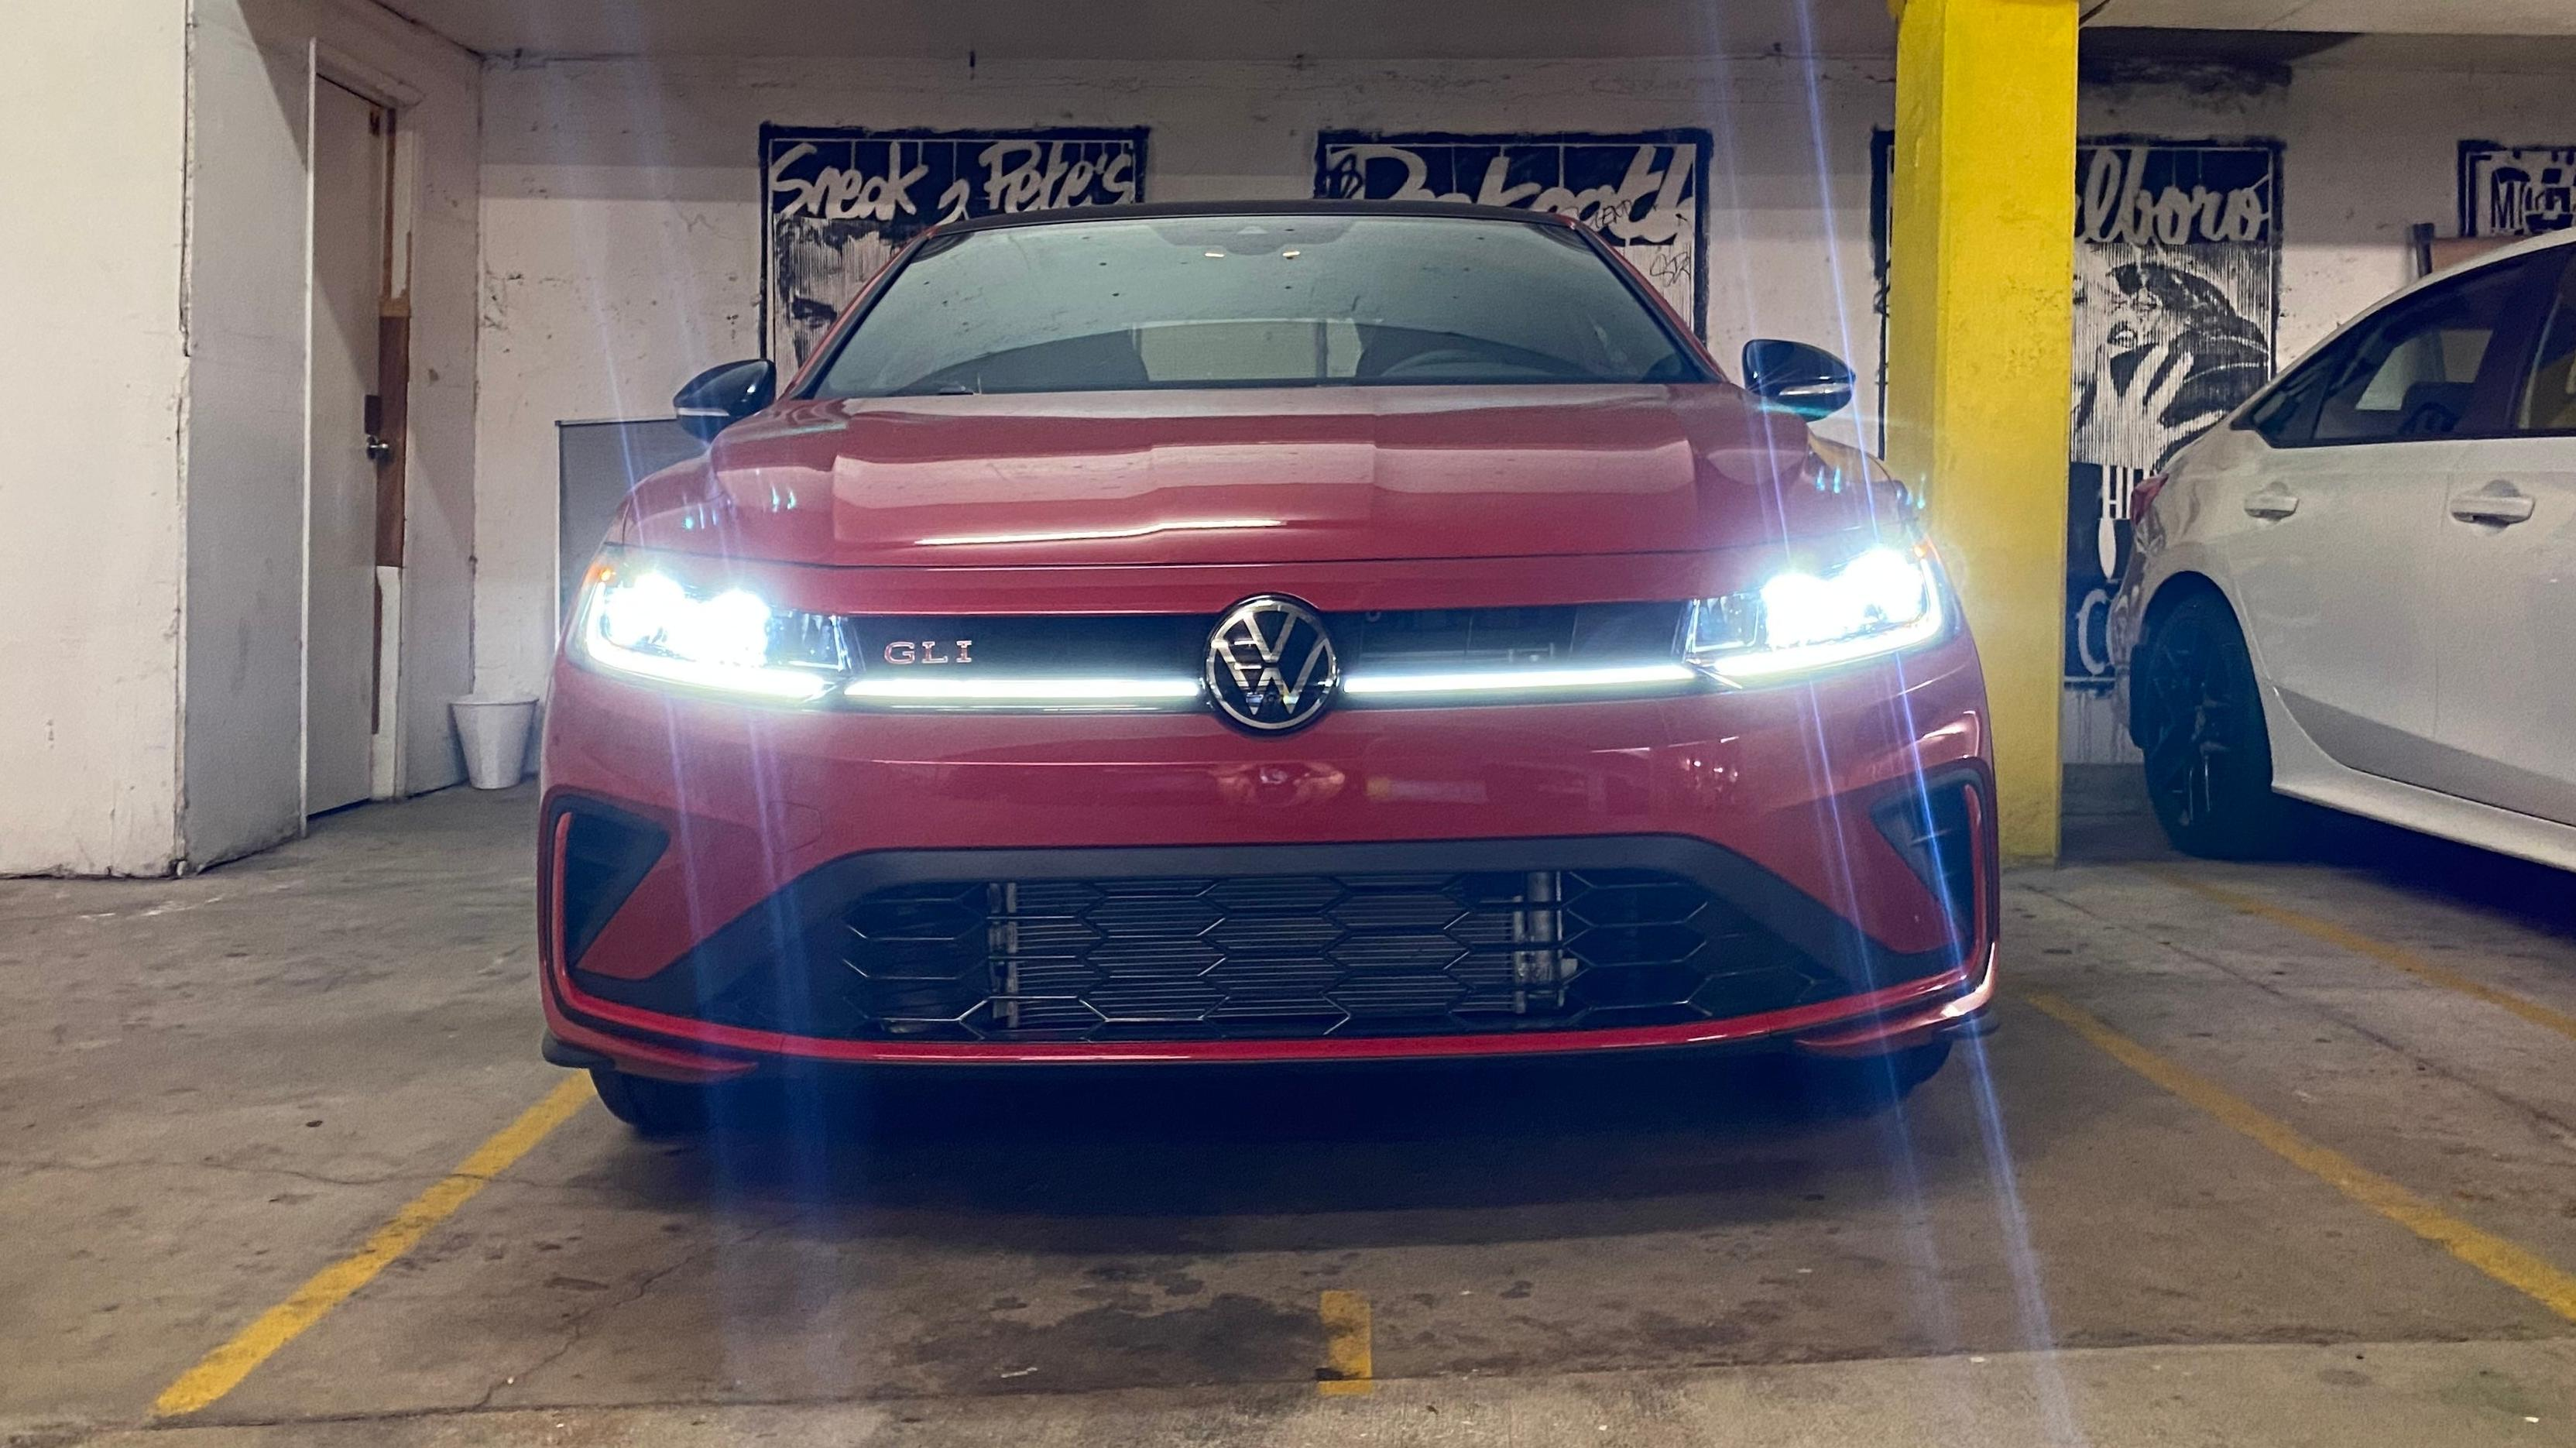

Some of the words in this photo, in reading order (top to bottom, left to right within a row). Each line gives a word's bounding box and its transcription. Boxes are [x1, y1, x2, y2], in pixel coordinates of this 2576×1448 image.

[773, 142, 929, 221] Sneak
[2075, 146, 2262, 245] lboro
[883, 640, 973, 664] GLI
